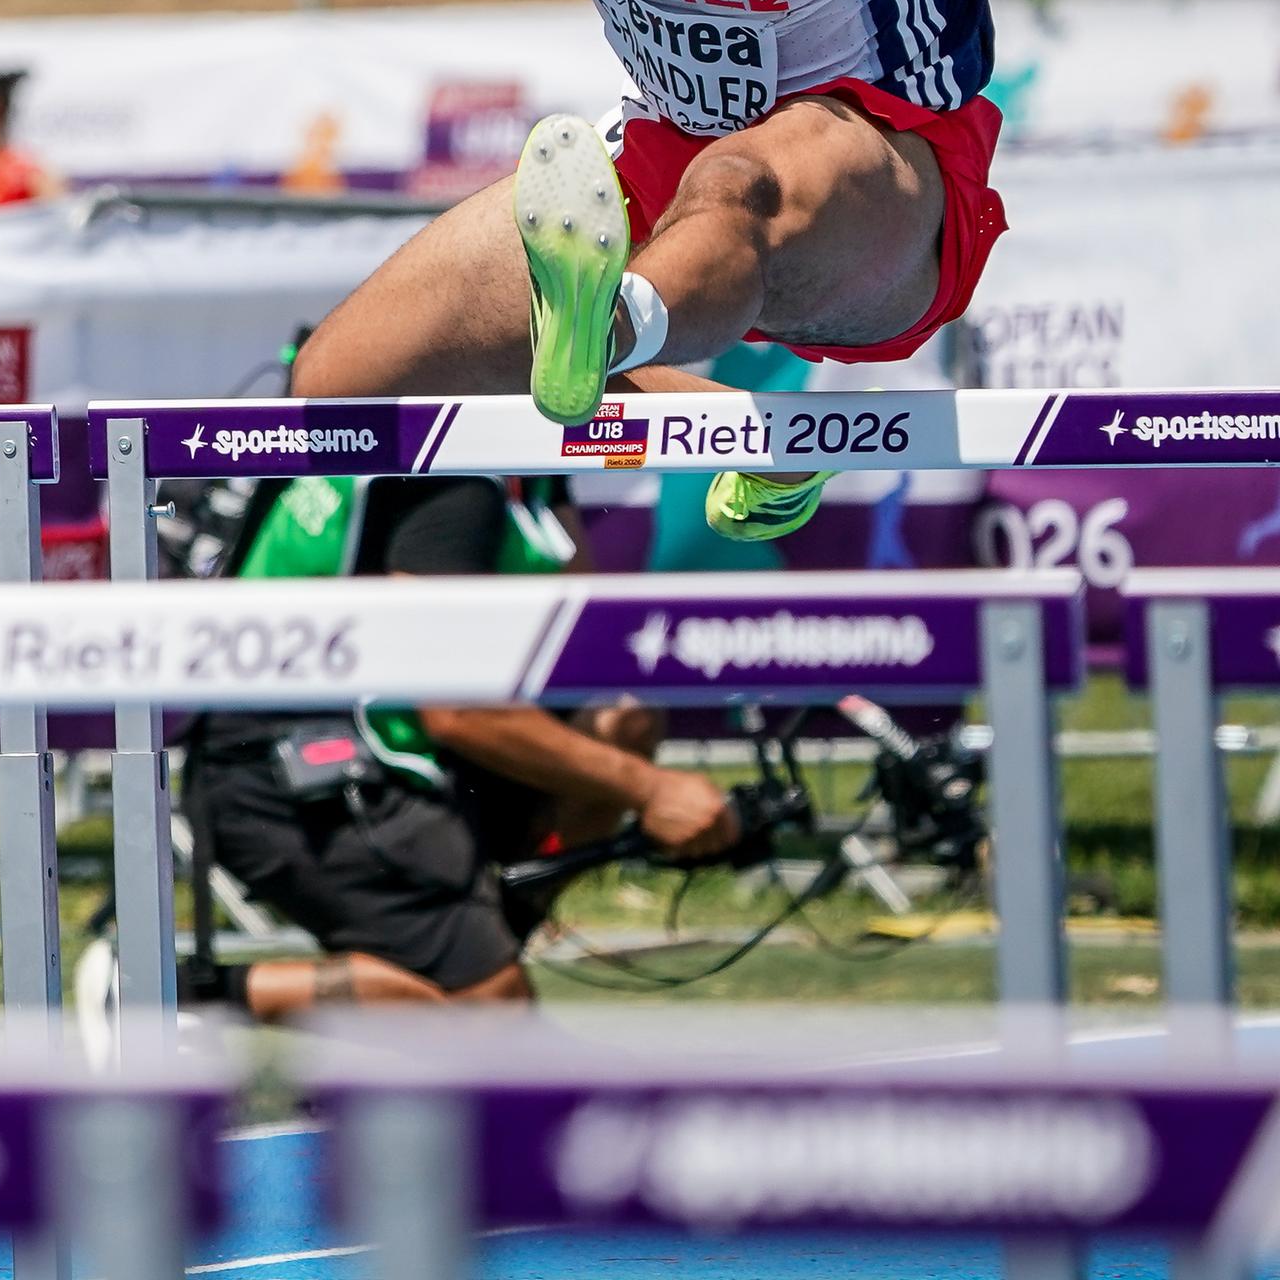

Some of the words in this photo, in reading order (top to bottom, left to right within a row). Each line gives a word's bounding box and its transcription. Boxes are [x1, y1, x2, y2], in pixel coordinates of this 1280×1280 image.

[211, 425, 378, 462] sportissimo
[589, 422, 623, 439] U18
[660, 412, 773, 455] Rieti
[785, 411, 911, 454] 2026
[1131, 411, 1280, 448] sportissim
[565, 444, 643, 453] CHAMPIONSHIPS
[183, 615, 357, 678] 2026
